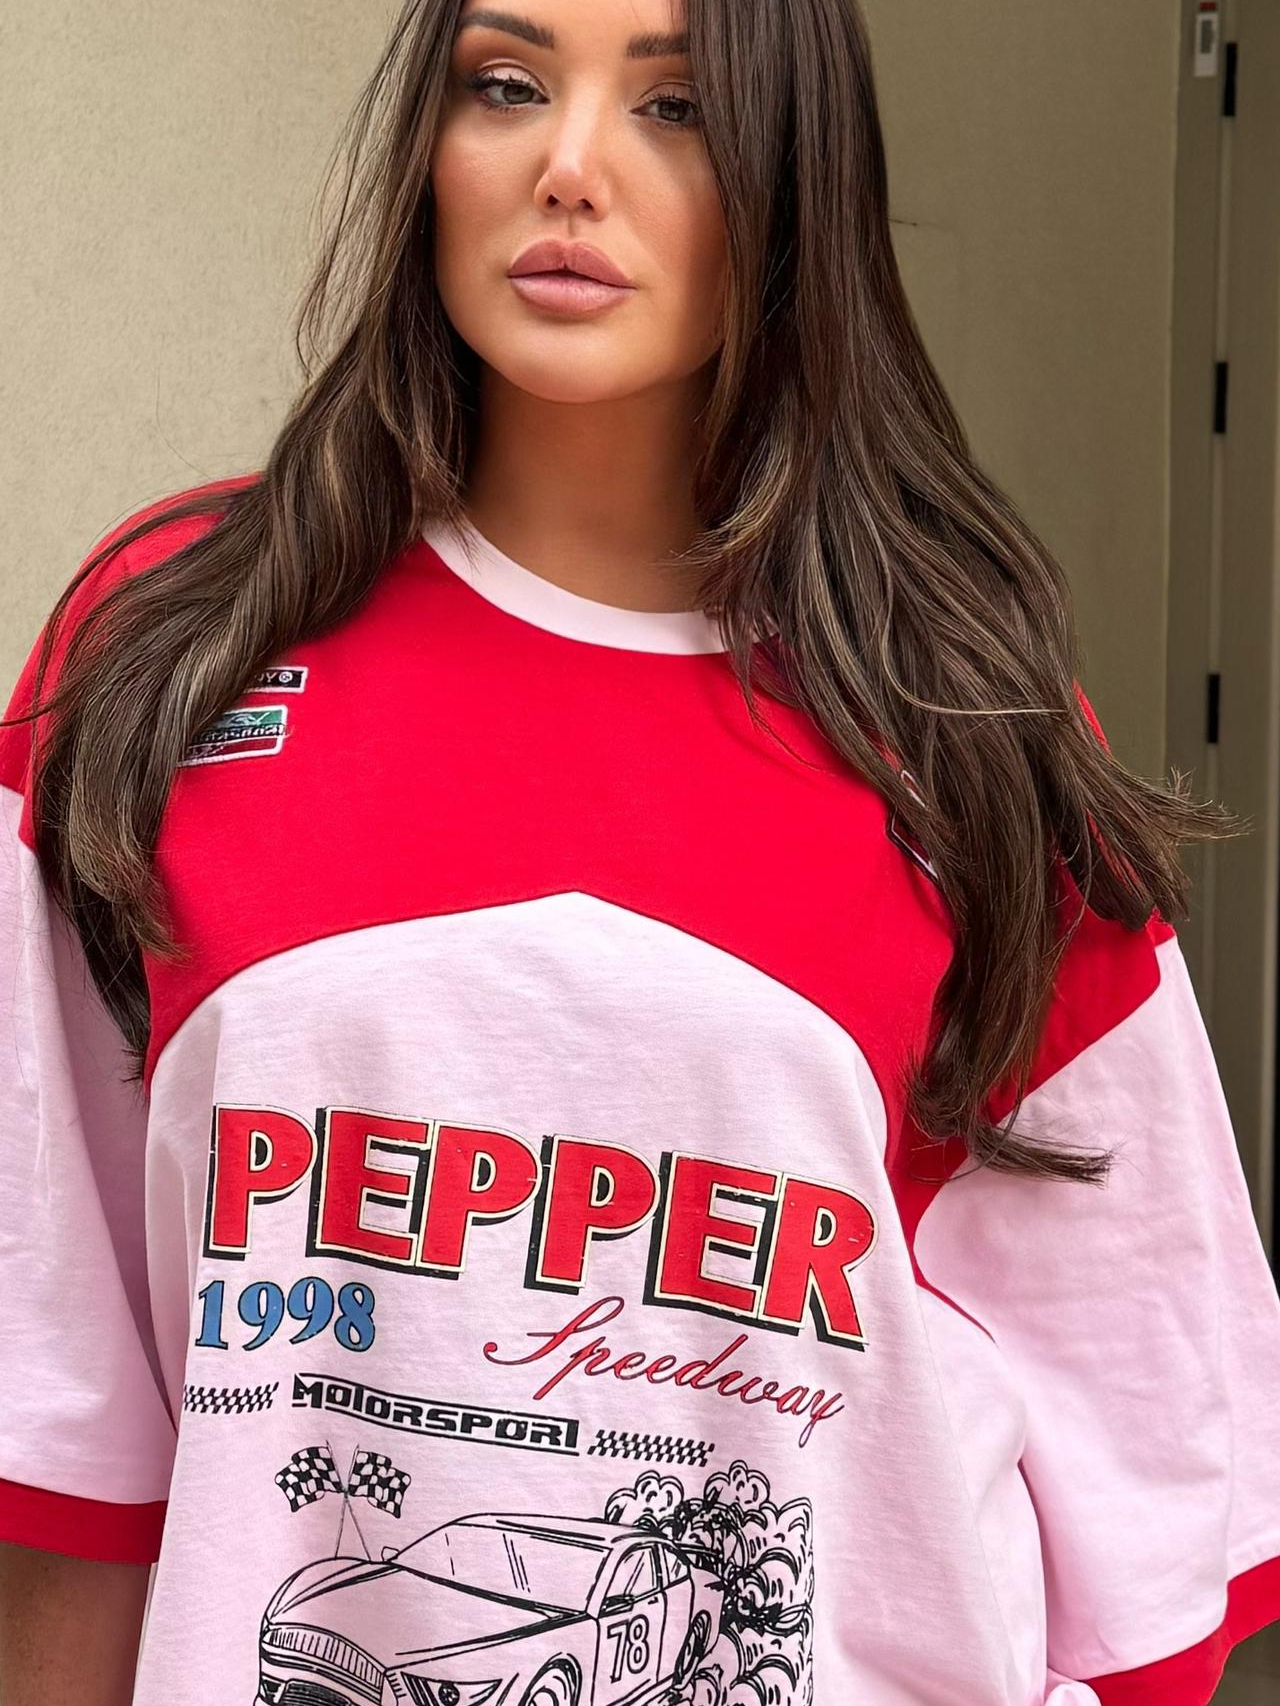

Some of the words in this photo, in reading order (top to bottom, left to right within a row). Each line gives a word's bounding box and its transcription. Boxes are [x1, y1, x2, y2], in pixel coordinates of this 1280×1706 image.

[203, 1103, 878, 1350] PEPPER
[195, 1276, 376, 1352] 1998
[484, 1296, 846, 1448] Speedway
[292, 1373, 580, 1450] MOTORSPORT
[607, 1615, 651, 1684] 78
